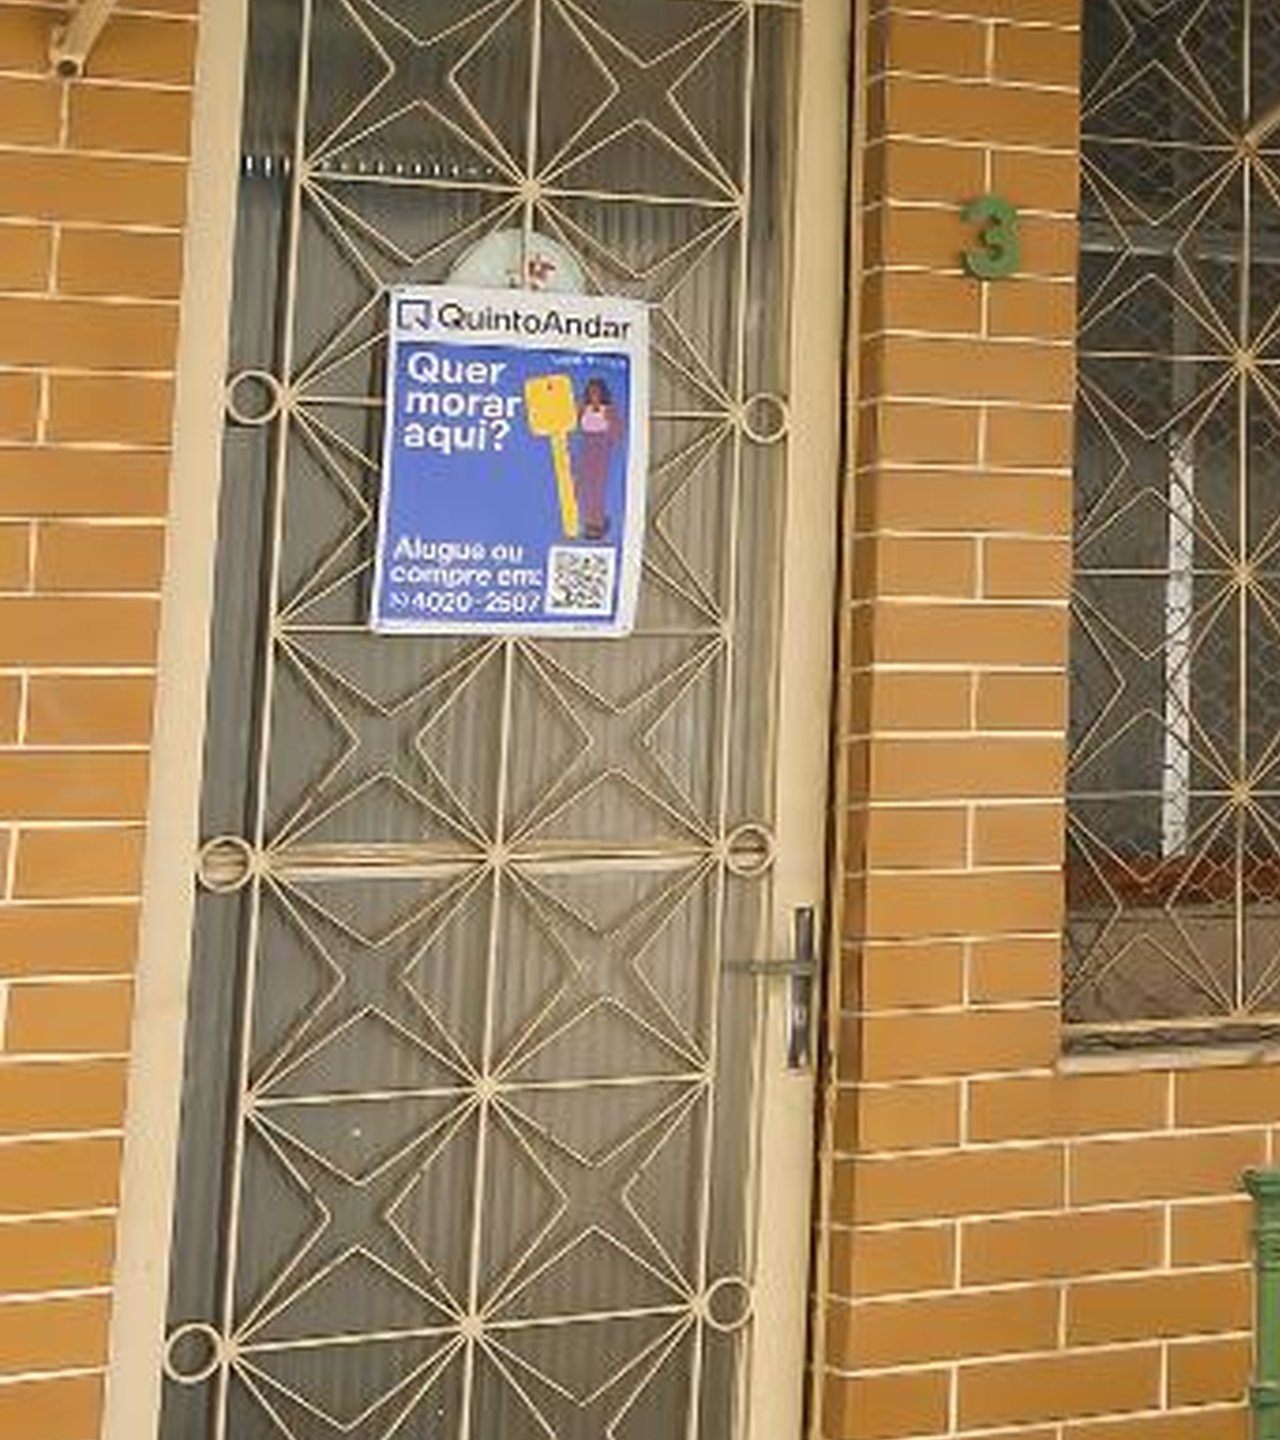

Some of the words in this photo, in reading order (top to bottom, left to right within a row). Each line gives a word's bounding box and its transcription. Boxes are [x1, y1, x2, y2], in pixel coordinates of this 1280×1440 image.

[961, 196, 1020, 278] 3
[438, 302, 631, 340] QuintoAndar
[408, 351, 507, 385] Quer
[405, 389, 521, 419] morar
[403, 420, 510, 456] aqui?
[393, 535, 485, 567] Alugue
[491, 542, 524, 564] ou
[390, 565, 492, 589] compre
